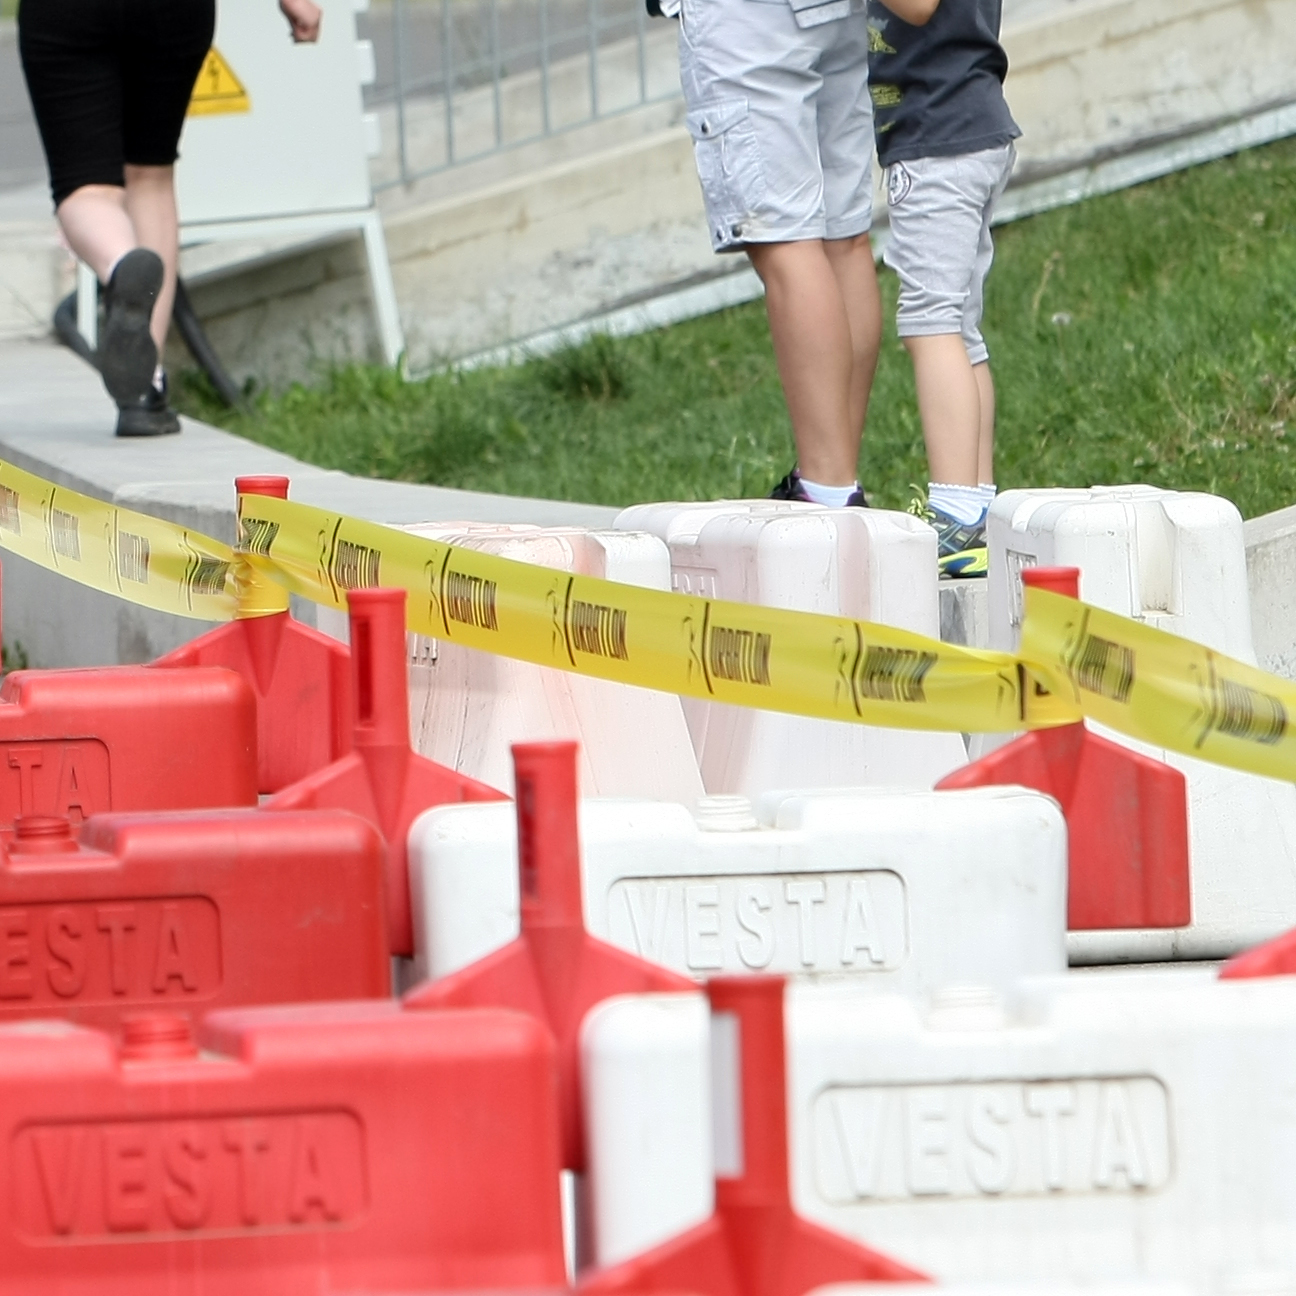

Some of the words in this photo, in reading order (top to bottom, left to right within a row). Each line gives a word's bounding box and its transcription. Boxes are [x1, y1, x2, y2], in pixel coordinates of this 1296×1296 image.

[448, 570, 499, 631] URBATLON
[572, 599, 629, 661] URBATLON
[711, 625, 772, 686] URBATLON
[623, 878, 887, 971] VESTA
[28, 1115, 342, 1237] VESTA
[830, 1082, 1149, 1197] VESTA
